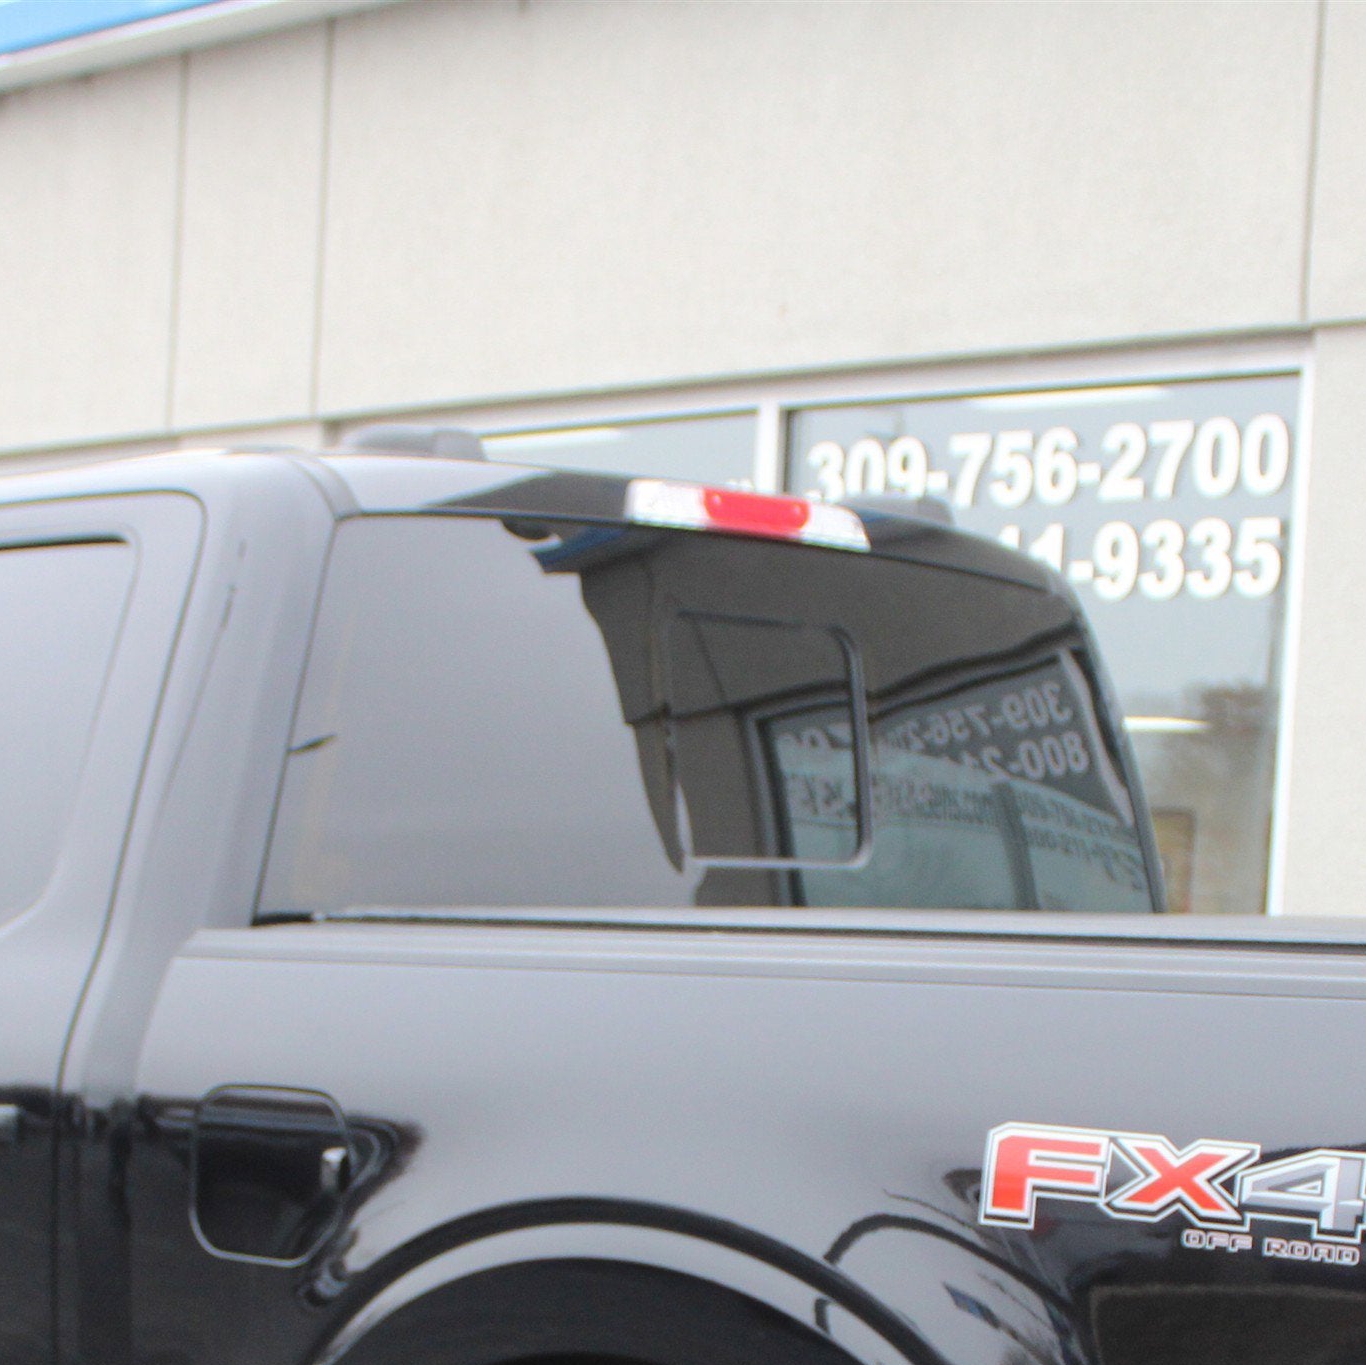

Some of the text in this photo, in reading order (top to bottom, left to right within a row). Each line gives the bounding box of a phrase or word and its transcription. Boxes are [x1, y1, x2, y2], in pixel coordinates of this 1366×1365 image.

[803, 413, 1290, 507] 309-756-2700
[1182, 1229, 1361, 1267] OFF ROAD
